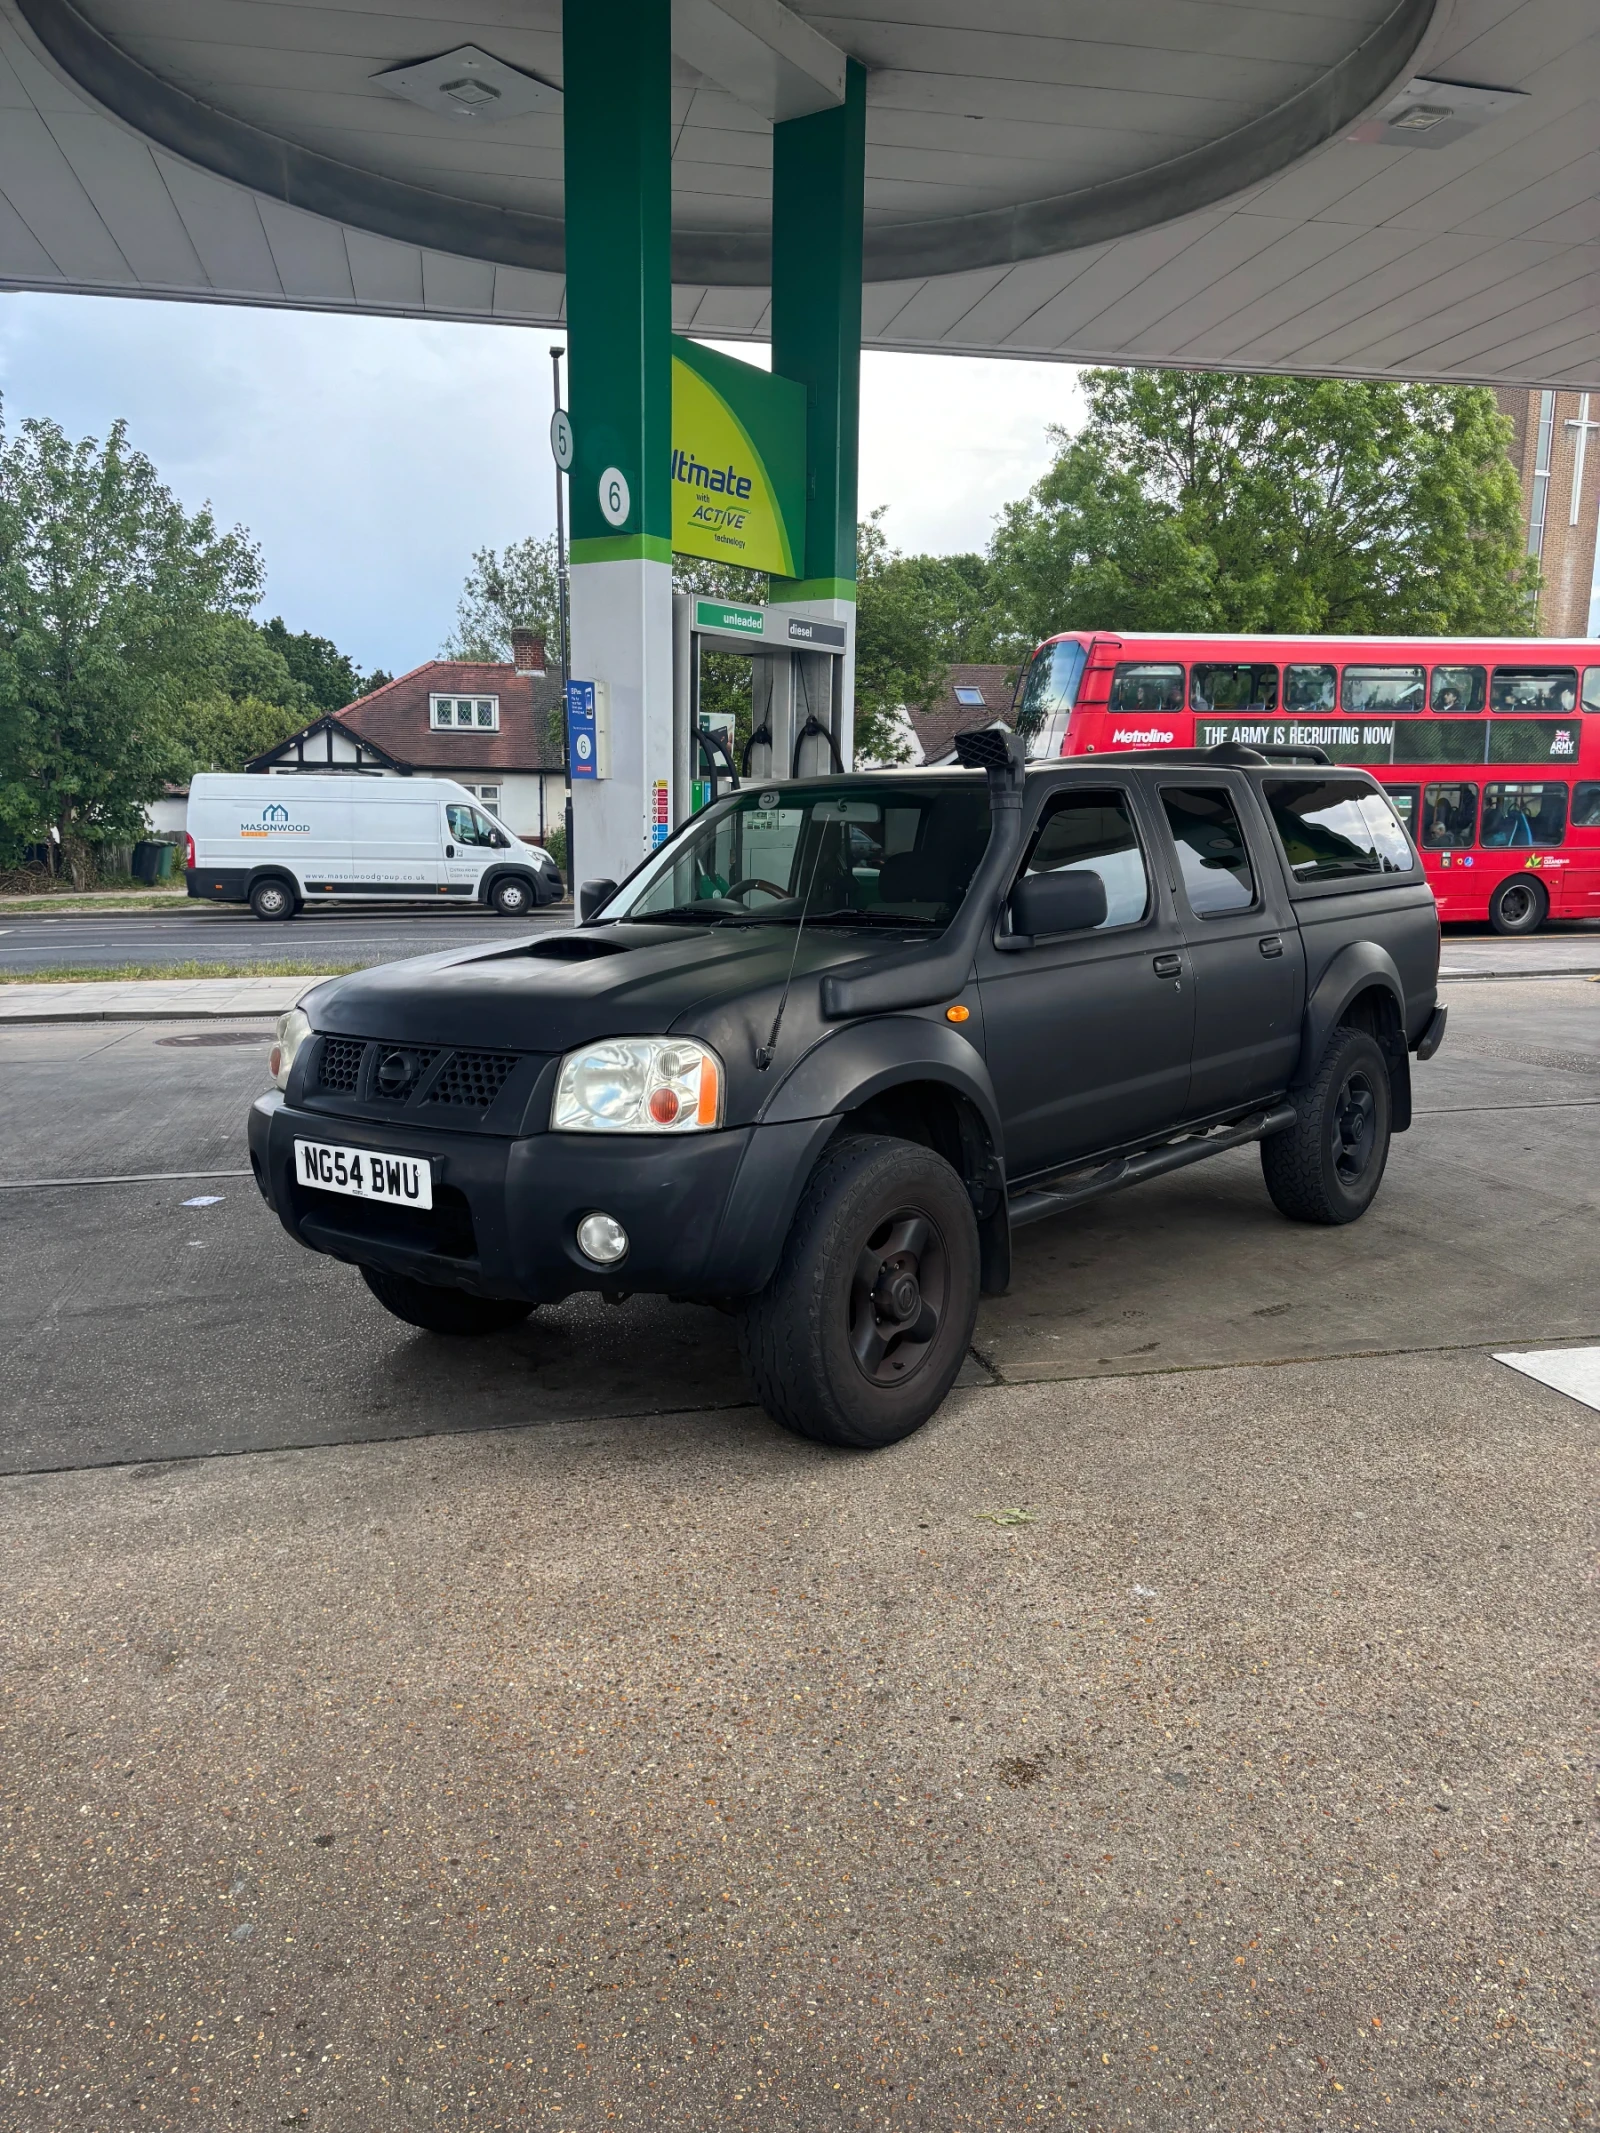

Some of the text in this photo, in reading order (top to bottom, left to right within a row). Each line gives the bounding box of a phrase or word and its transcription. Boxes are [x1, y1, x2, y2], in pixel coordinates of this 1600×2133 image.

[558, 424, 567, 456] 5
[672, 449, 752, 500] ltimate
[608, 481, 620, 512] 6
[696, 493, 710, 503] with
[692, 505, 746, 529] ACTIVE
[714, 533, 746, 550] technology
[723, 613, 762, 629] unleaded
[789, 623, 813, 638] diesel
[1112, 728, 1174, 744] Metroline
[1204, 726, 1395, 745] THE ARMY IS RECRUITING NOW
[580, 741, 587, 754] 6
[1551, 741, 1575, 750] ARMY
[240, 823, 310, 832] MASONWOOD
[305, 872, 425, 882] www.masonwoodgoup.co.uk
[304, 1146, 420, 1200] NG54 BWU
